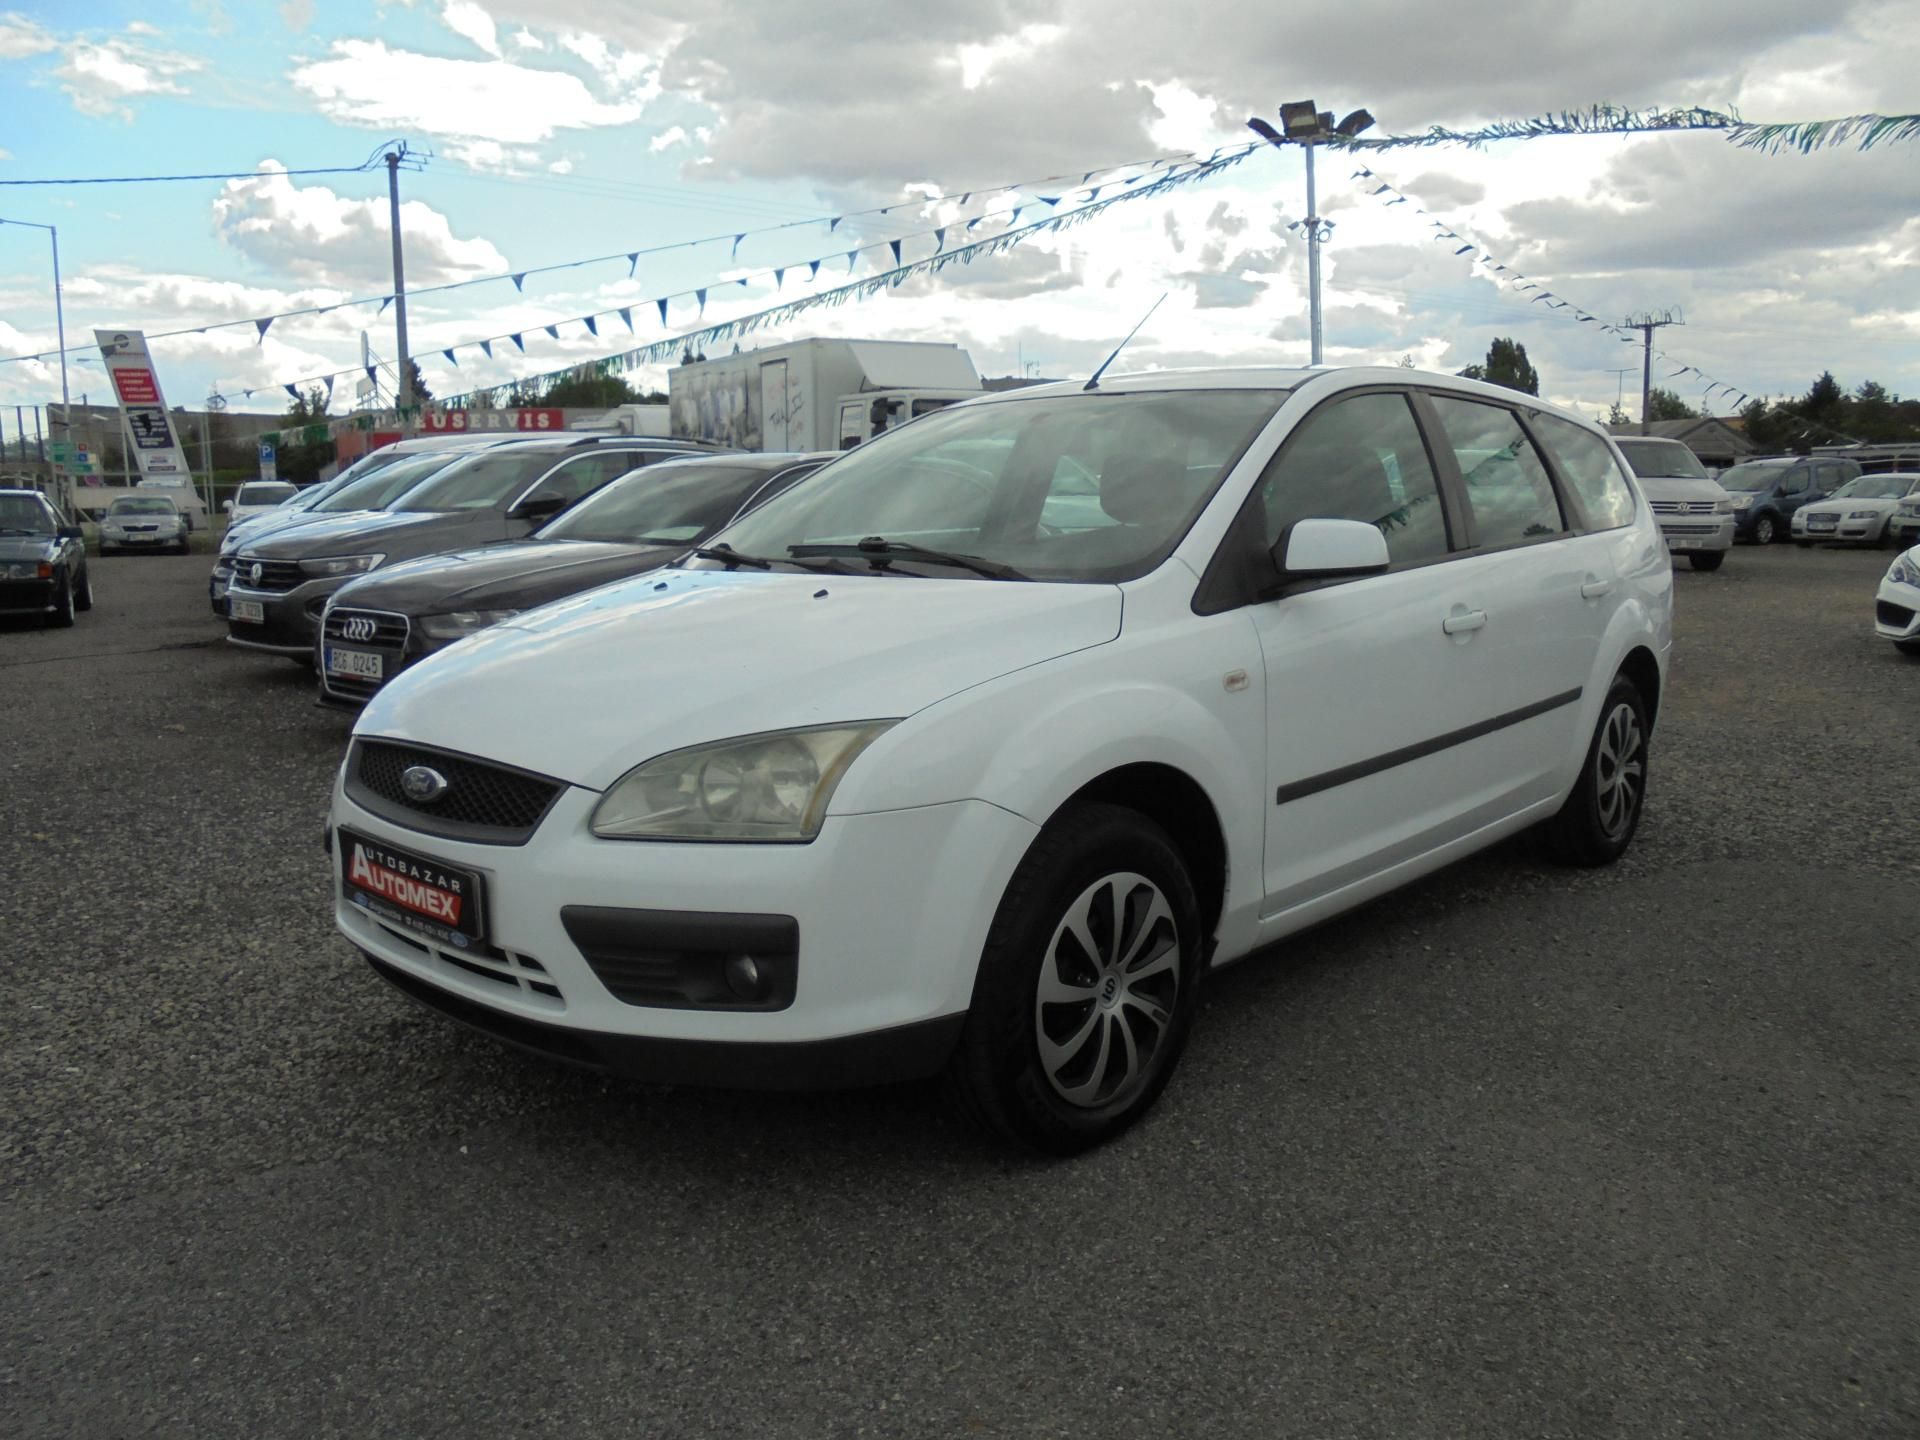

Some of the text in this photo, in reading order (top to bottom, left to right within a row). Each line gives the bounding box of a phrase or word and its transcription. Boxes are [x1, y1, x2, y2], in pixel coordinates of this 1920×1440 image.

[262, 445, 272, 457] P
[353, 653, 378, 675] 0245
[353, 843, 456, 920] AUTOMEX
